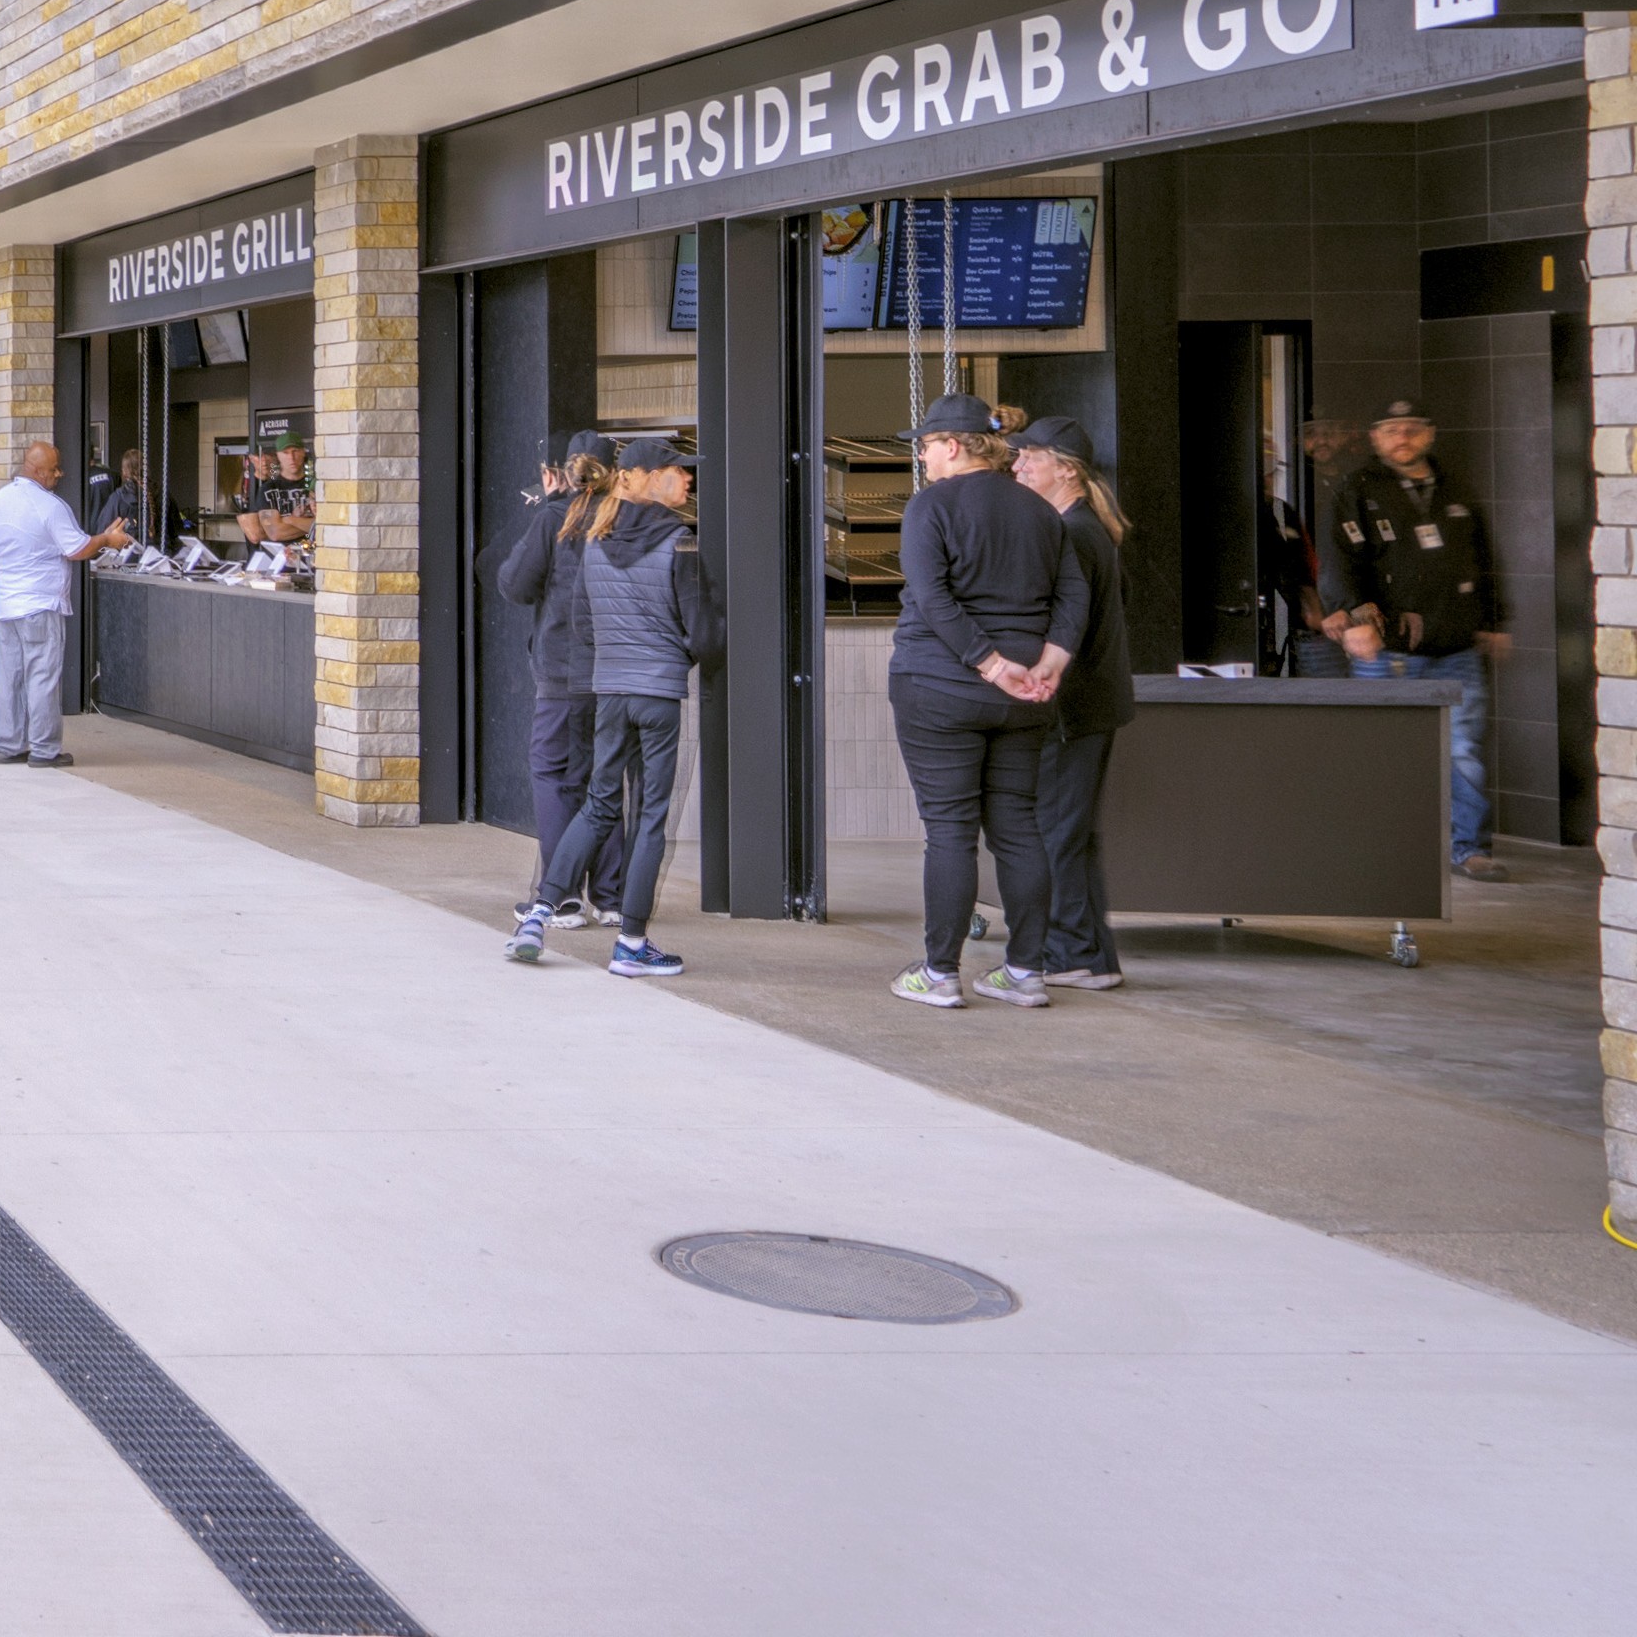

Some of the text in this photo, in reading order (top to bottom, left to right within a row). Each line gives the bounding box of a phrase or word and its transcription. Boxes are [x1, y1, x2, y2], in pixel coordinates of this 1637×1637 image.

[548, 70, 832, 210] RIVERSIDE
[856, 13, 1066, 141] GRAB
[109, 207, 311, 303] RIVERSIDE GRILL
[972, 206, 989, 214] Quick
